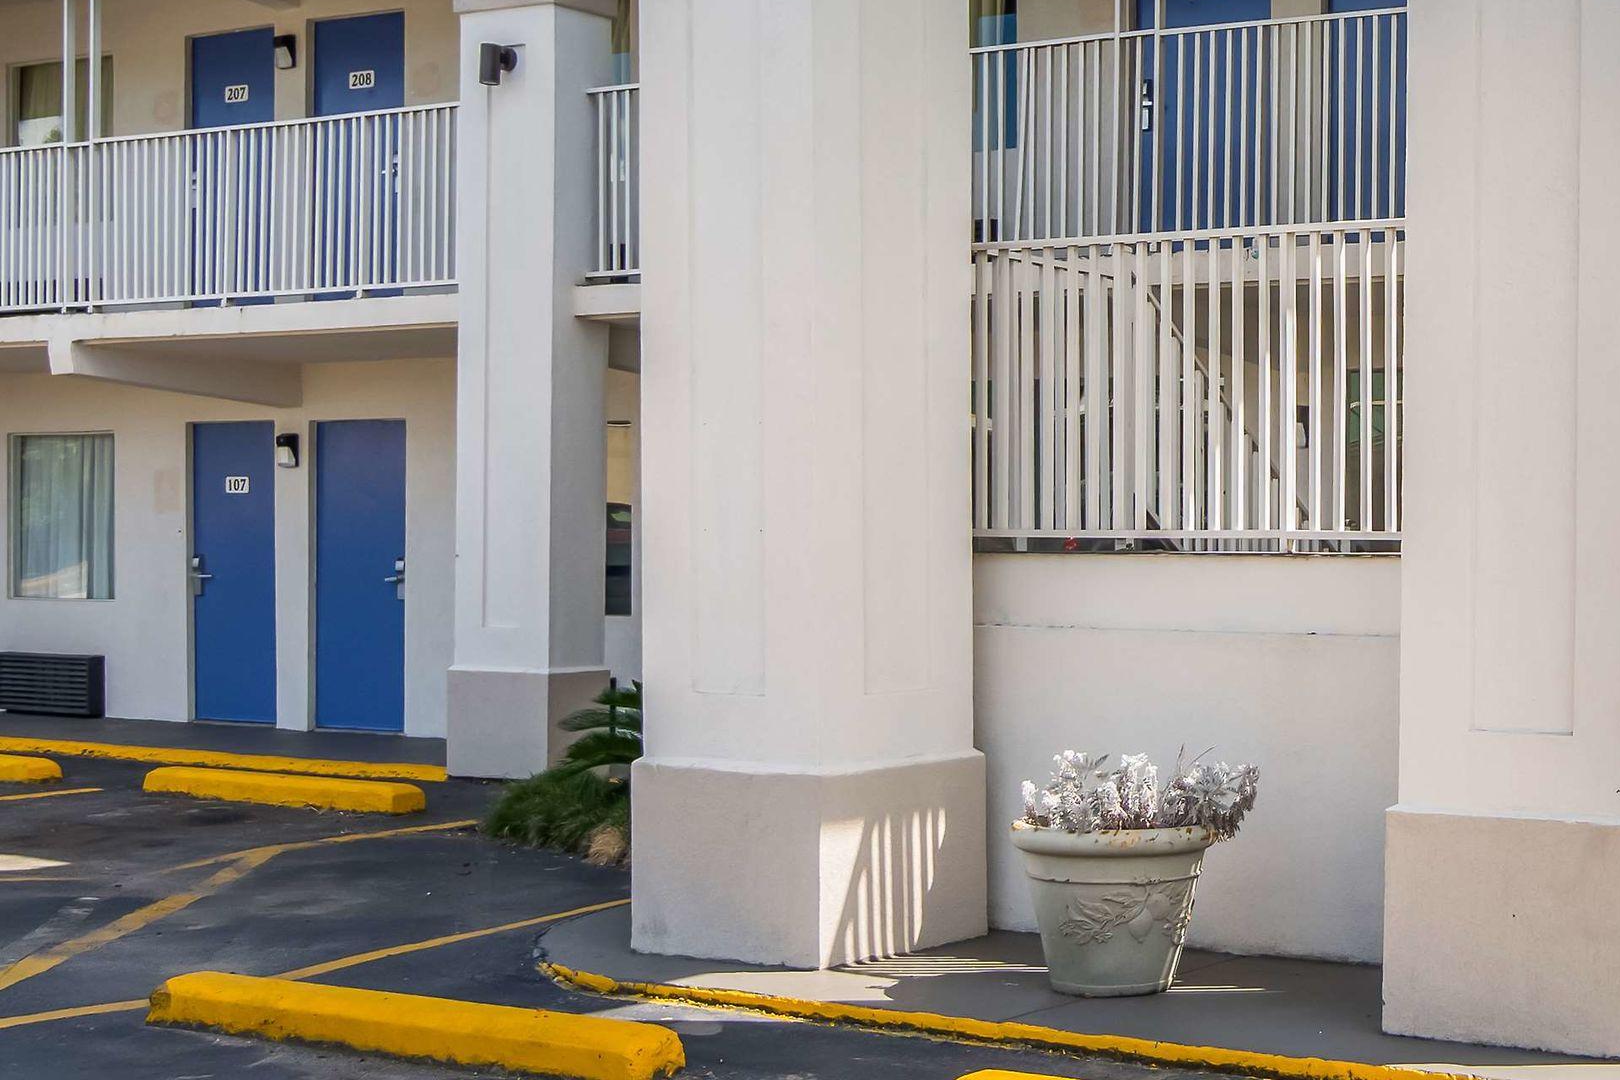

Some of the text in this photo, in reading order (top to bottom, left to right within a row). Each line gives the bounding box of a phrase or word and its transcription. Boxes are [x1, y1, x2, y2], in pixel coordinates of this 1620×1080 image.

[351, 72, 372, 88] 208
[226, 86, 247, 101] 207
[228, 478, 247, 492] 107
